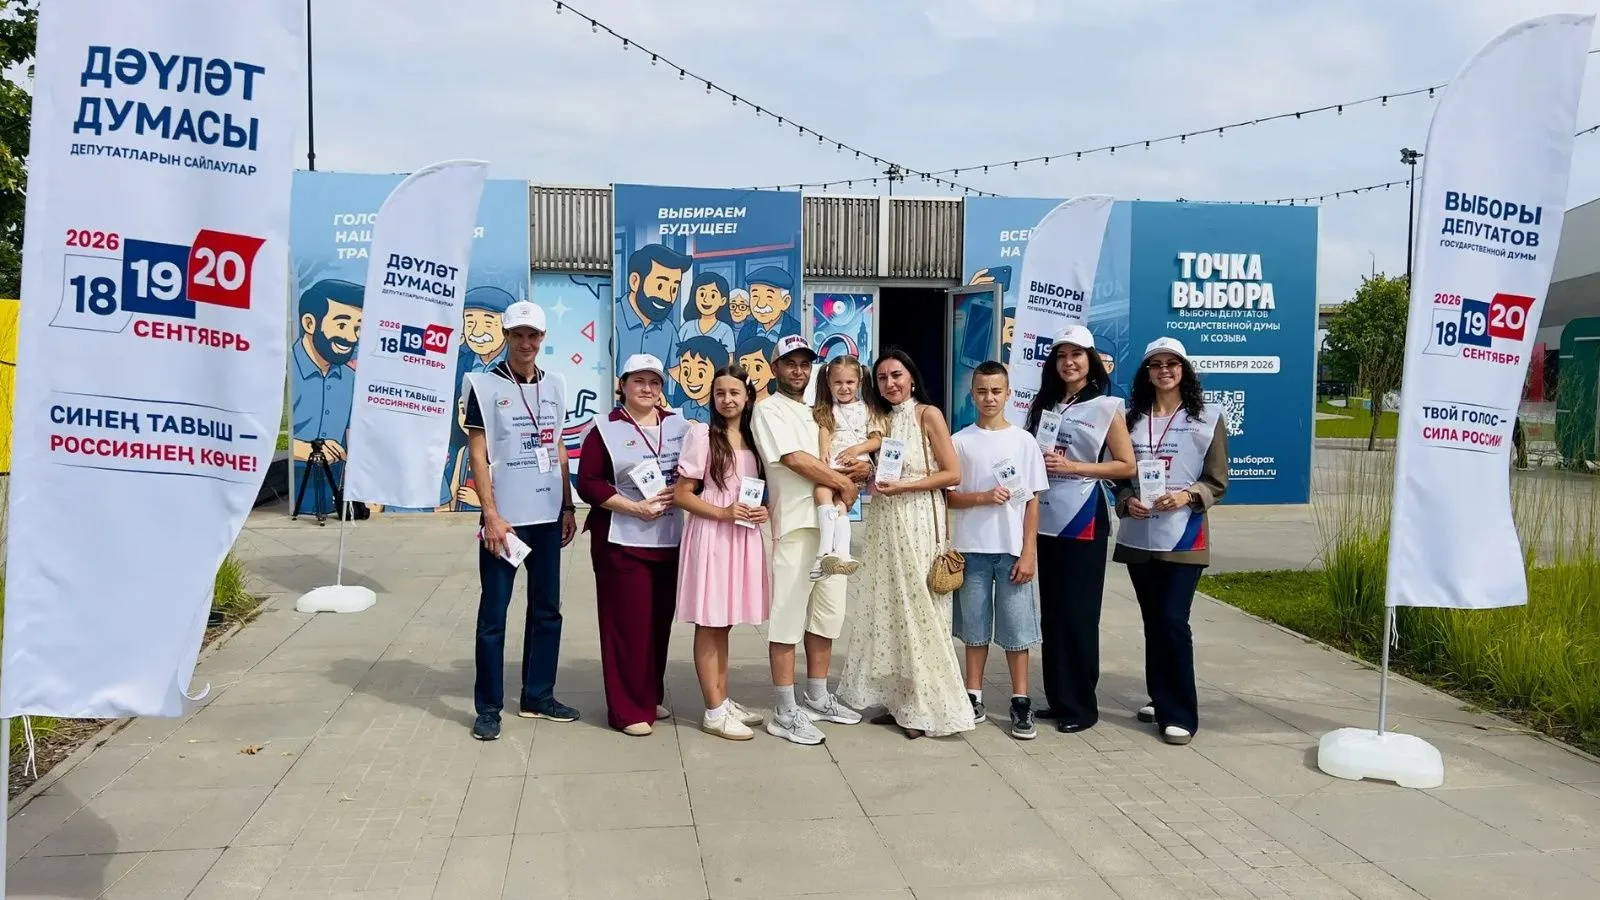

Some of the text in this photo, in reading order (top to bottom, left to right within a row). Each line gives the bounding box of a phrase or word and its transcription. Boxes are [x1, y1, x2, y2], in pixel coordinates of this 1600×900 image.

[81, 45, 266, 100] ДӘҮЛӘТ
[73, 96, 259, 151] ДУМАСЫ
[70, 143, 257, 176] ДЕПУТАТЛАРЫН САЙЛАУЛАР
[658, 207, 747, 219] ВЫБИРАЕМ
[1445, 191, 1542, 225] ВЫБОРЫ
[659, 222, 738, 236] БУДУЩЕЕ!
[1442, 218, 1539, 247] ДЕПУТАТОВ
[65, 229, 119, 251] 2026
[1000, 246, 1021, 257] НА
[1440, 239, 1537, 261] ГОСУДАРСТВЕННОЙ ДУМЫ
[387, 253, 458, 280] ДӘҮЛӘТ
[1177, 252, 1262, 280] ТОЧКА
[70, 247, 246, 316] 18 19 20
[384, 272, 455, 299] ДУМАСЫ
[1030, 280, 1085, 301] ВЫБОРЫ
[1028, 295, 1082, 313] ДЕПУТАТОВ
[1171, 280, 1275, 309] ВЫБОРА
[1434, 293, 1461, 306] 2026
[1179, 310, 1268, 319] ВЫБОРЫ ДЕПУТАТОВ
[379, 320, 400, 329] 2026
[1166, 320, 1280, 331] ГОСУДАРСТВЕННОЙ ДУМЫ
[1435, 303, 1525, 346] 18 19 20
[133, 320, 250, 352] СЕНТЯБРЬ
[380, 330, 446, 353] 18 19 20
[1210, 334, 1247, 342] СОЗЫВА
[403, 355, 446, 369] СЕНТЯБРЬ
[1023, 347, 1034, 360] 18
[1462, 347, 1520, 366] СЕНТЯБРЯ
[1199, 360, 1249, 368] СЕНТЯБРЯ
[1251, 360, 1274, 368] 2026
[368, 384, 402, 398] СИНЕҢ
[404, 390, 437, 403] ТАВЫШ
[1014, 390, 1031, 400] ТВОЙ
[368, 396, 445, 414] РОССИЯНЕҢ КӨЧЕ!
[1422, 405, 1458, 421] ТВОЙ
[50, 405, 139, 434] СИНЕҢ
[147, 413, 233, 441] ТАВЫШ
[541, 432, 553, 440] 20
[1423, 427, 1458, 441] СИЛА
[50, 435, 257, 472] РОССИЯНЕҢ КӨЧЕ!
[1233, 454, 1275, 465] выборах
